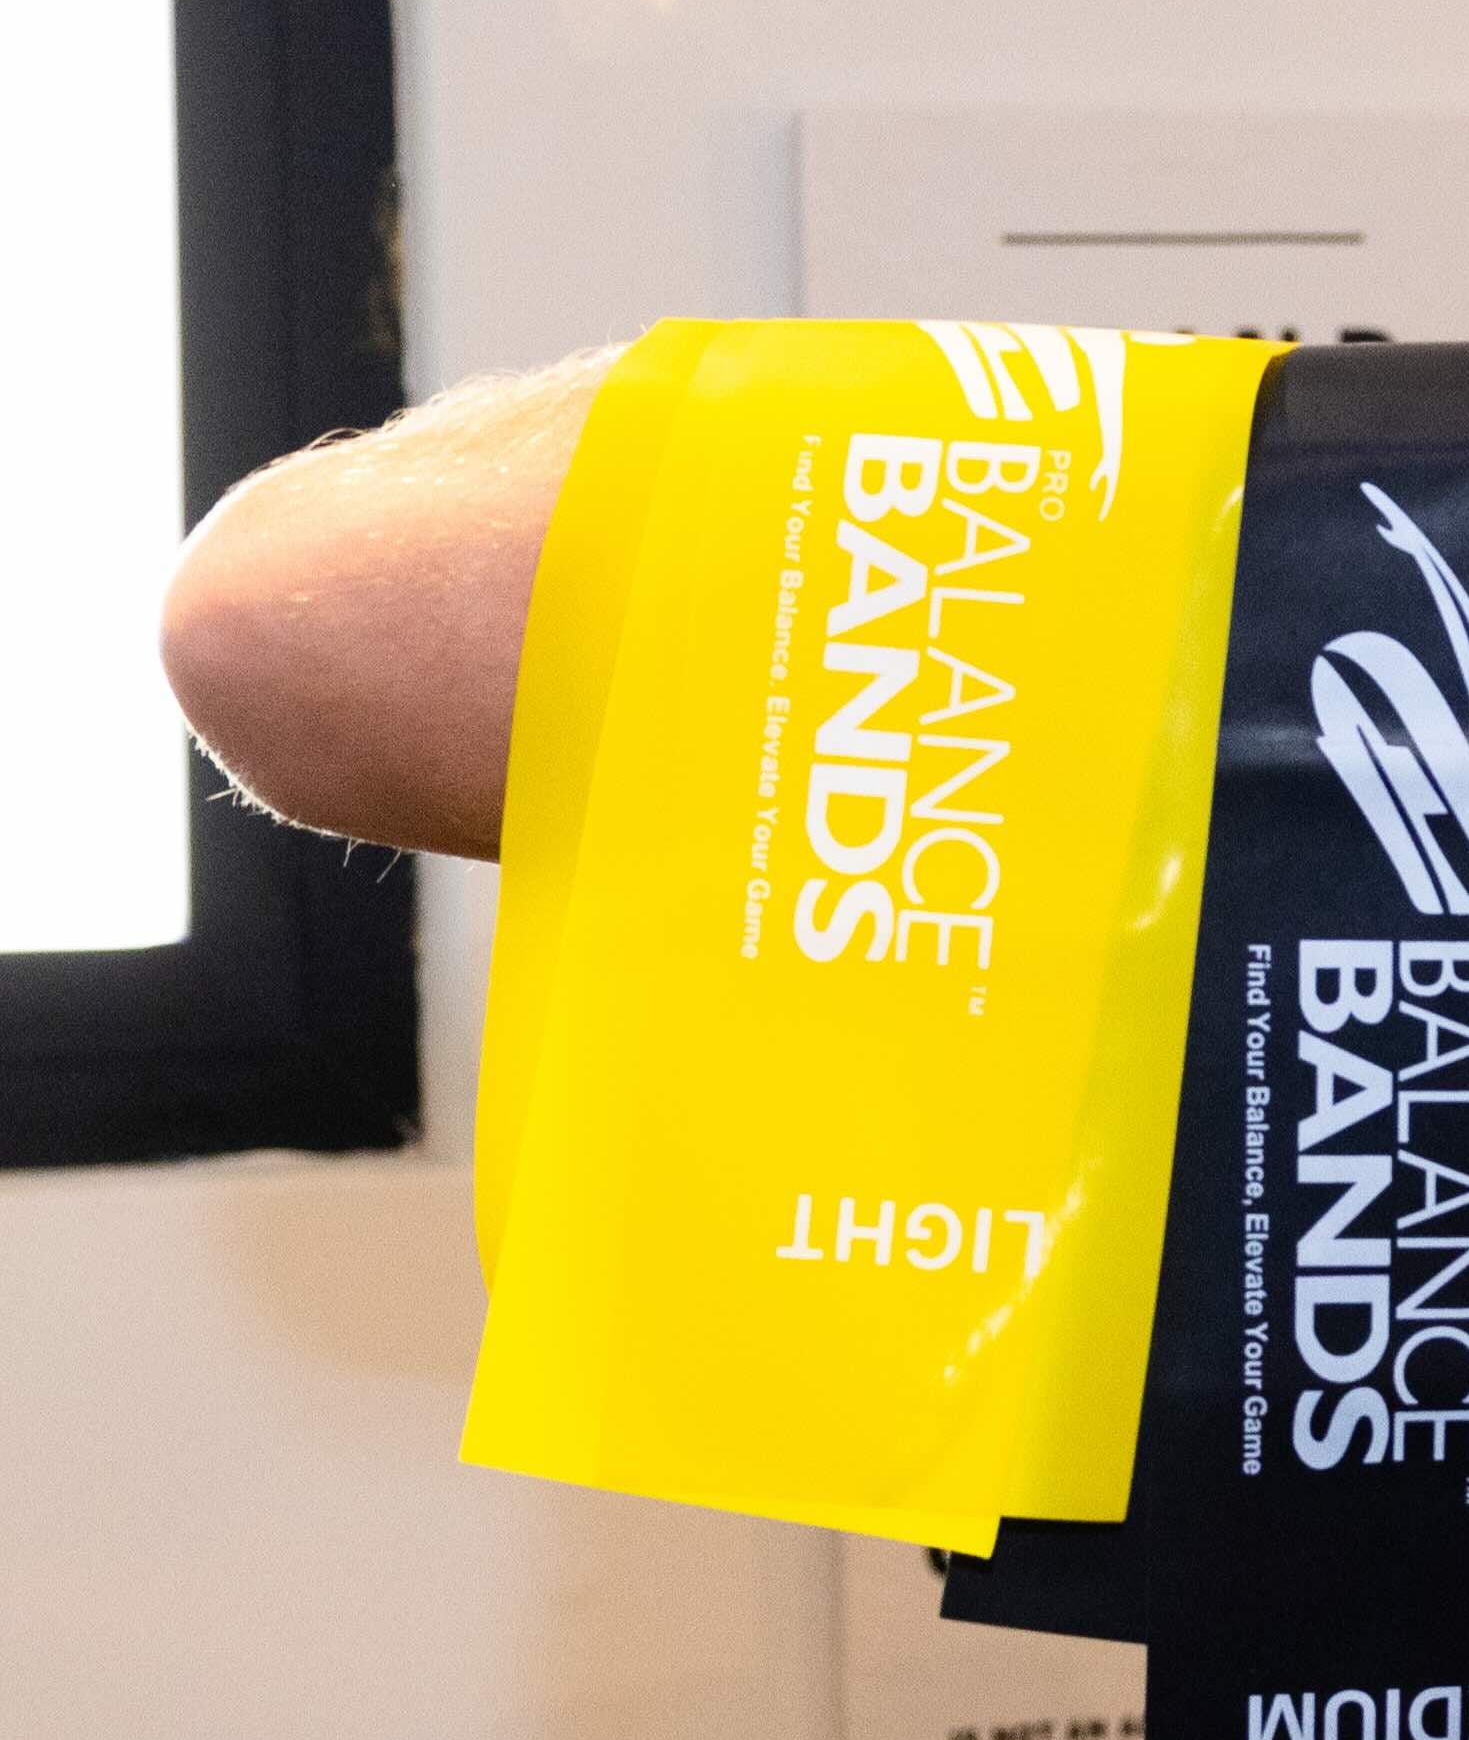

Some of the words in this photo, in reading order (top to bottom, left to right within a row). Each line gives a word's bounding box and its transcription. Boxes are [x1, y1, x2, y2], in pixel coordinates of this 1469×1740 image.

[791, 433, 822, 492] Find
[1039, 449, 1073, 522] PRO
[784, 499, 811, 563] Your
[793, 432, 943, 964] BANDS
[895, 440, 1042, 970] BALANCE
[757, 695, 791, 799] Elevate
[750, 806, 780, 873] Your
[740, 877, 772, 961] Game
[1246, 943, 1272, 1006] Find
[1245, 1011, 1272, 1081] Your
[1240, 1085, 1271, 1207] Balance,
[775, 1193, 1046, 1279] LIGHT
[1291, 938, 1394, 1470] BANDS
[1243, 1212, 1270, 1316] Elevate
[1242, 1322, 1269, 1390] Your
[1241, 1394, 1269, 1475] Game
